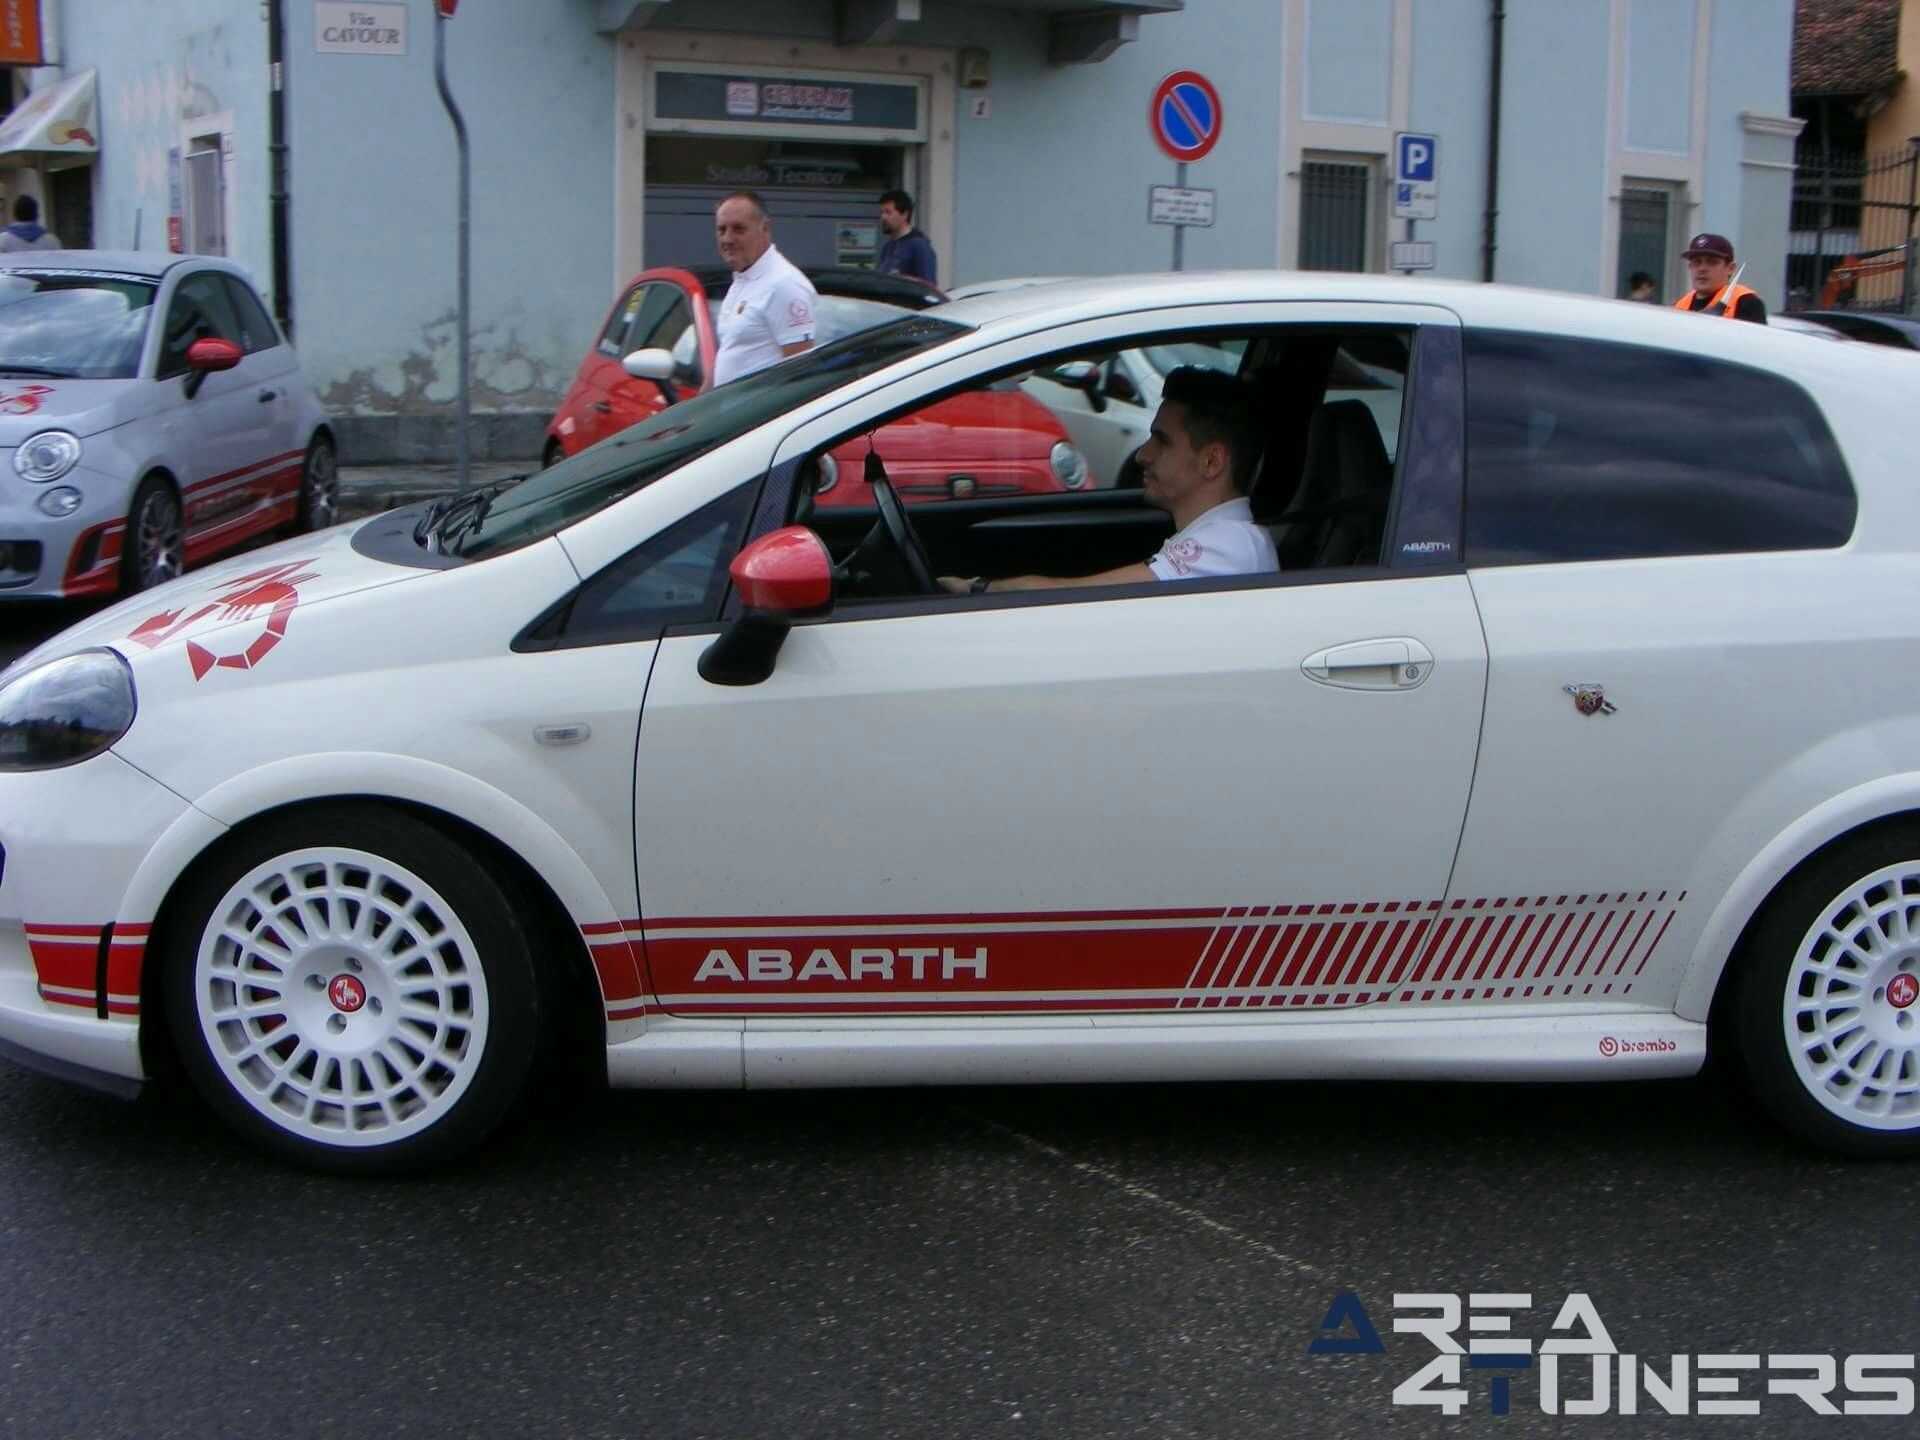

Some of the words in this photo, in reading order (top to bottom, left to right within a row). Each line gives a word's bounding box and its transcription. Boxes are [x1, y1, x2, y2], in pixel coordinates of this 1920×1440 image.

[349, 11, 376, 26] Via
[322, 26, 400, 44] CAVOUR
[1406, 142, 1429, 175] P
[693, 947, 989, 983] ABARTH
[1621, 1038, 1677, 1052] brembo
